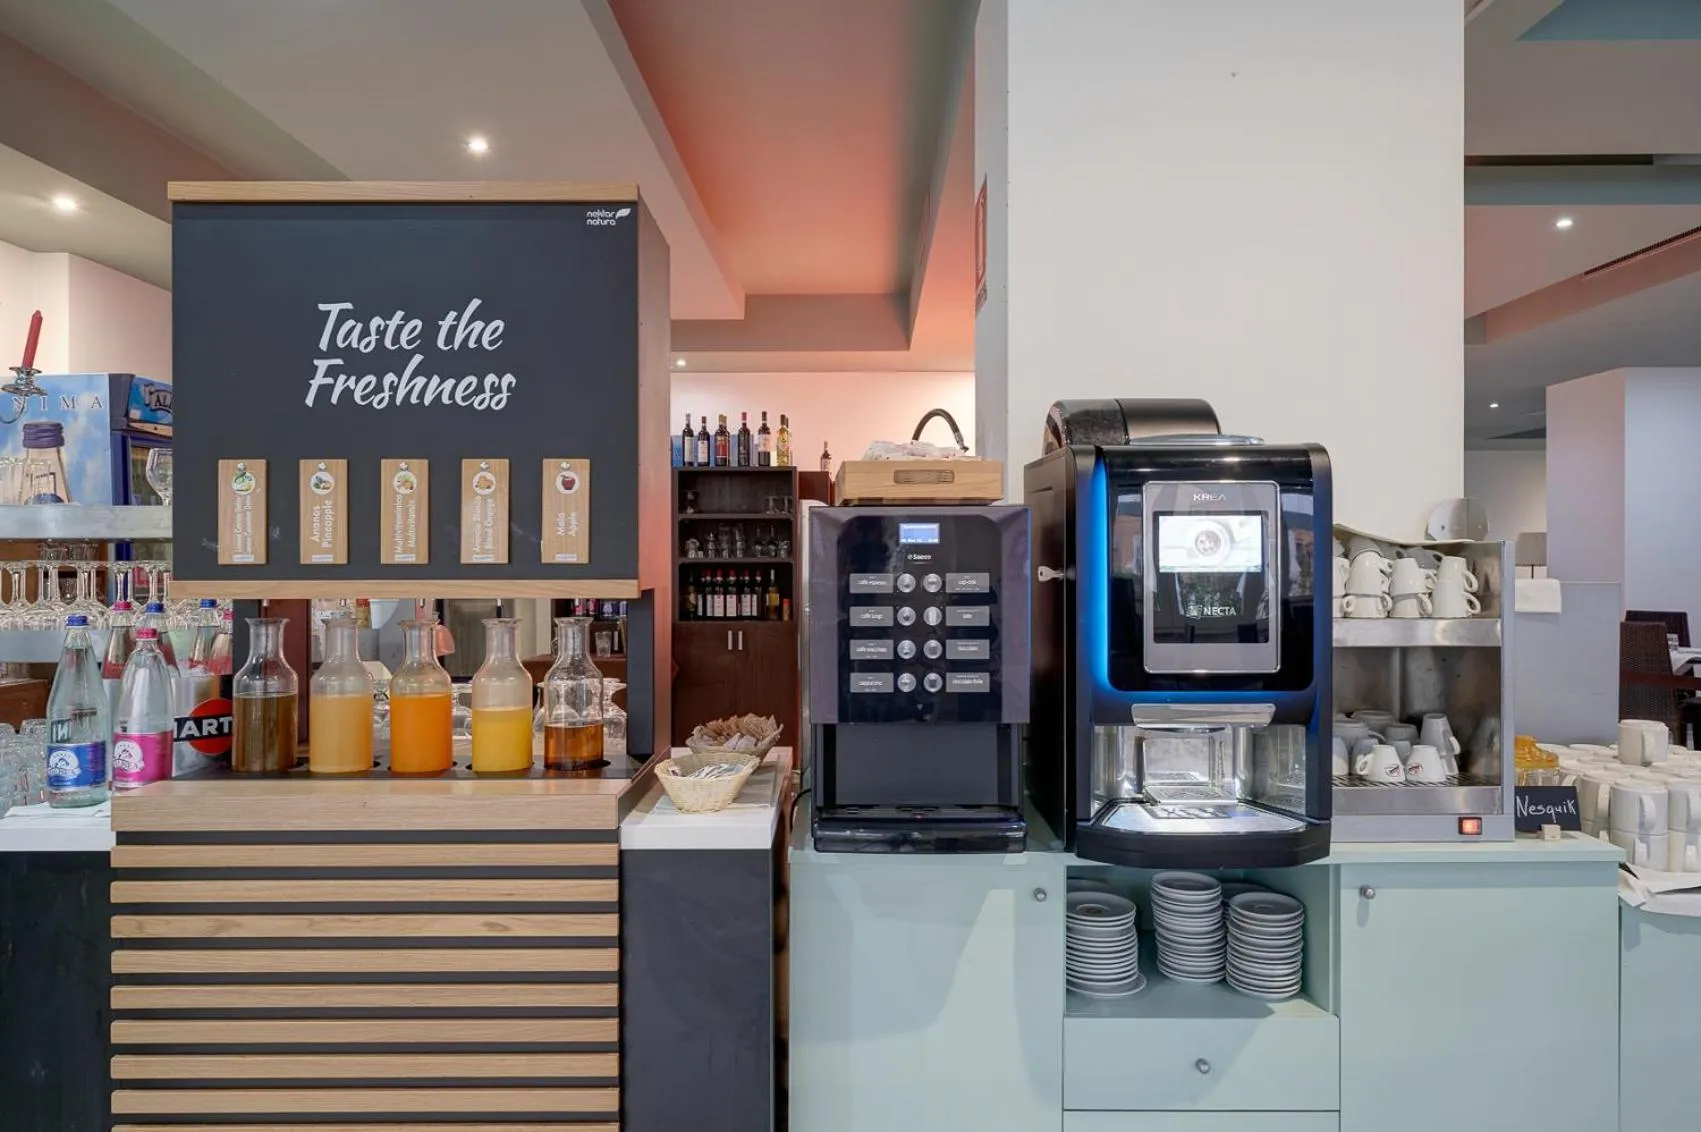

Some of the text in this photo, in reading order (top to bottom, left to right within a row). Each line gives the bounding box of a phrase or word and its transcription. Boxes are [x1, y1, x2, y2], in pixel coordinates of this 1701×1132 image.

[586, 218, 617, 226] natura
[317, 298, 505, 353] Taste the
[304, 353, 517, 411] Freshness
[310, 505, 320, 542] Ananas
[321, 499, 333, 548] Pineapple
[568, 511, 578, 537] Apple
[1204, 606, 1237, 616] NECTA
